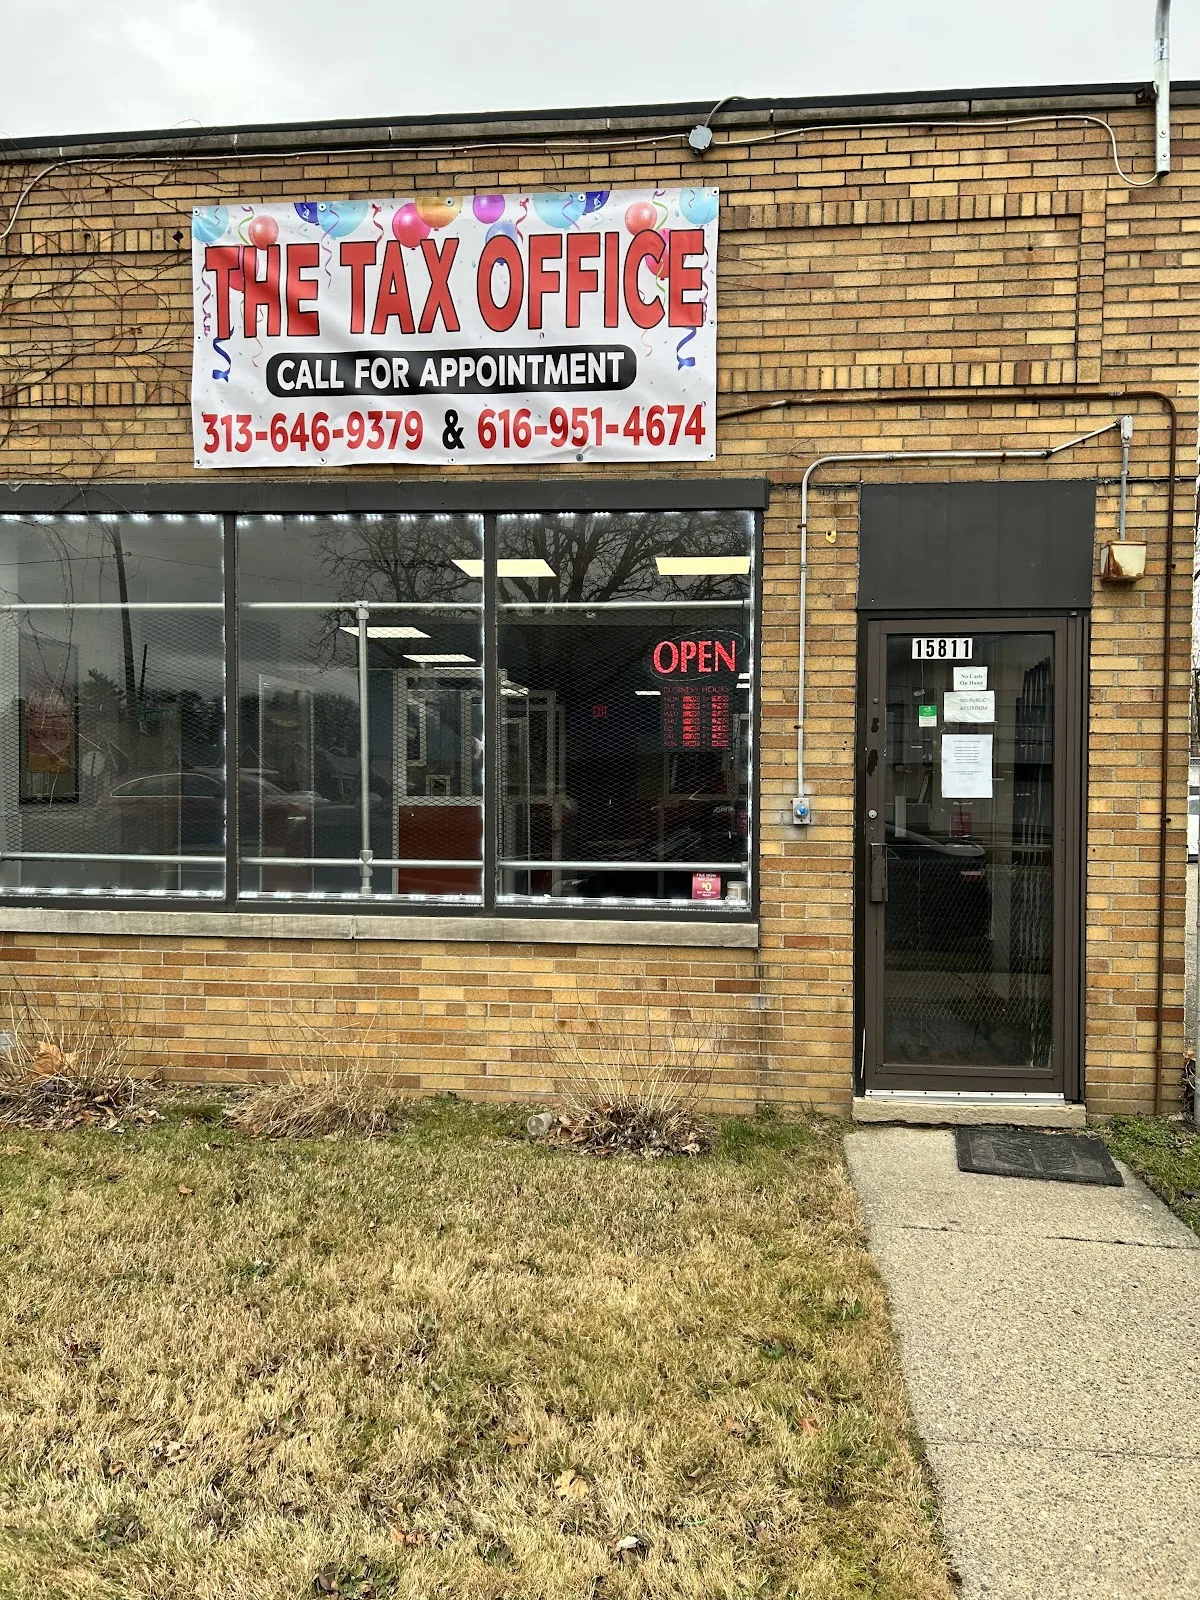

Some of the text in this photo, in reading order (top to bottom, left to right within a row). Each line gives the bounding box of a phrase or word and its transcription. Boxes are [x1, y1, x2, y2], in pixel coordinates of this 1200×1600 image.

[204, 228, 706, 340] THE TAX OFFICE
[276, 352, 626, 391] CALL FOR APPOINTMENT
[202, 405, 706, 453] 313-646-9379 & 616-951-4674
[653, 640, 736, 674] OPEN
[916, 639, 969, 658] 15811
[663, 685, 729, 694] BUSINESS HOURS
